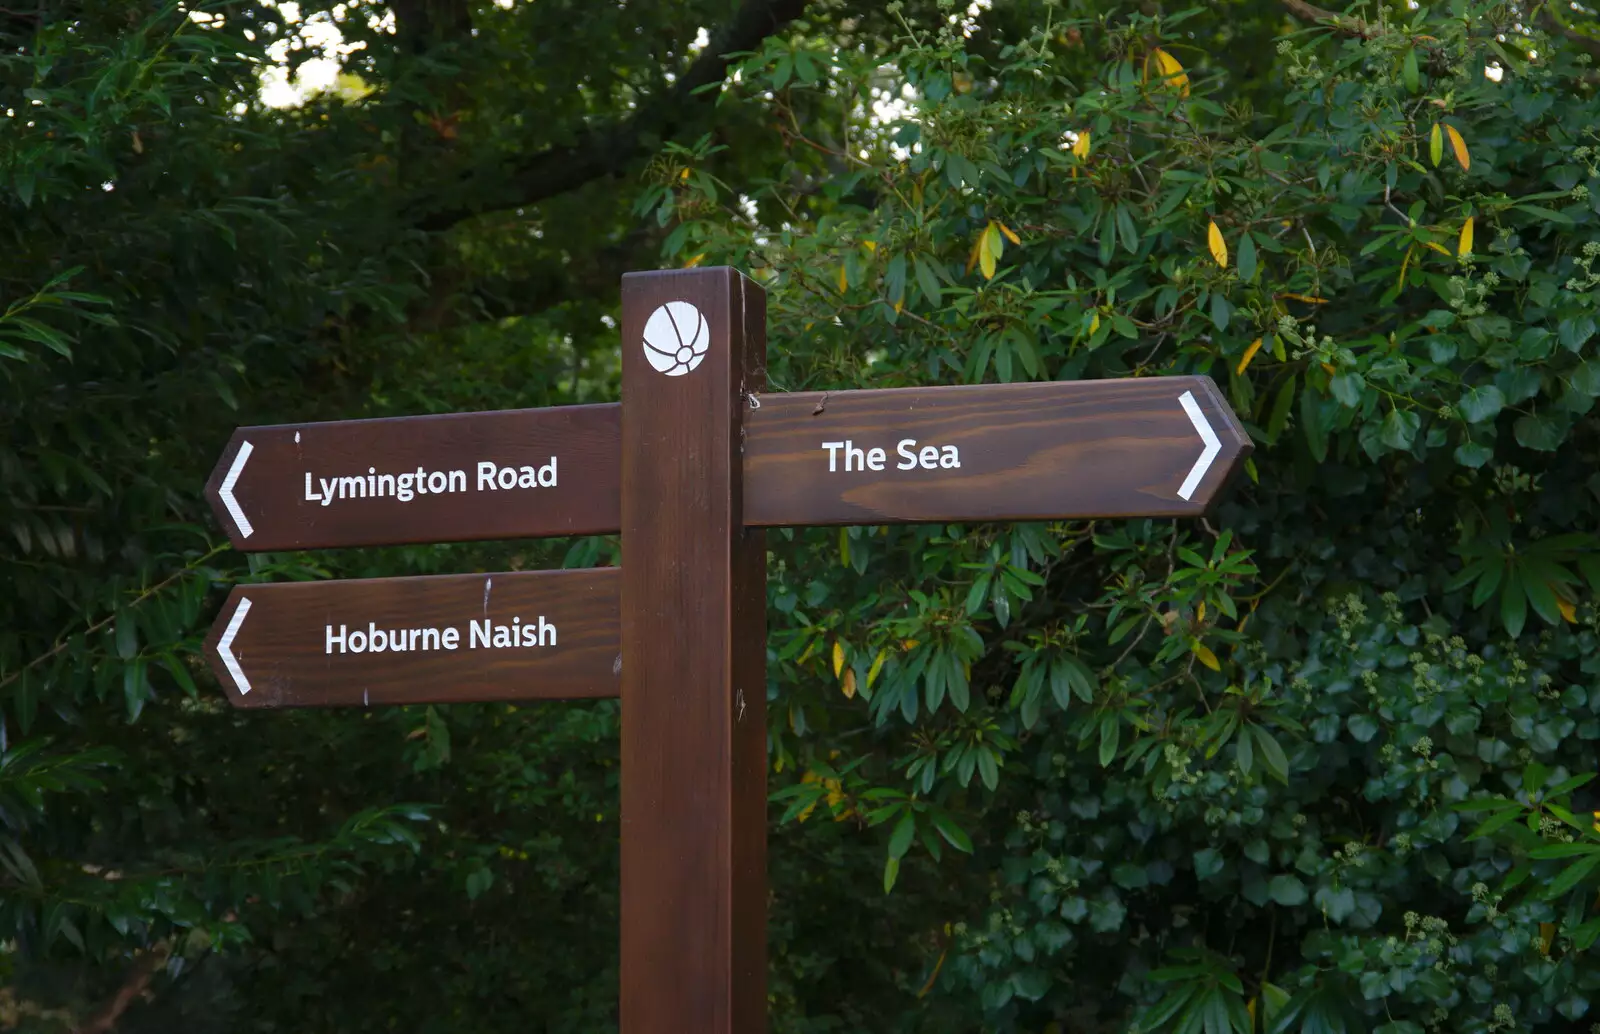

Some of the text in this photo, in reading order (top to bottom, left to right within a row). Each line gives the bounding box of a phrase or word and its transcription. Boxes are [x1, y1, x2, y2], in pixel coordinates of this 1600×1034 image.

[821, 438, 962, 473] The Sea
[304, 456, 558, 507] Lymington Road
[325, 615, 557, 654] Hoburne Naish
